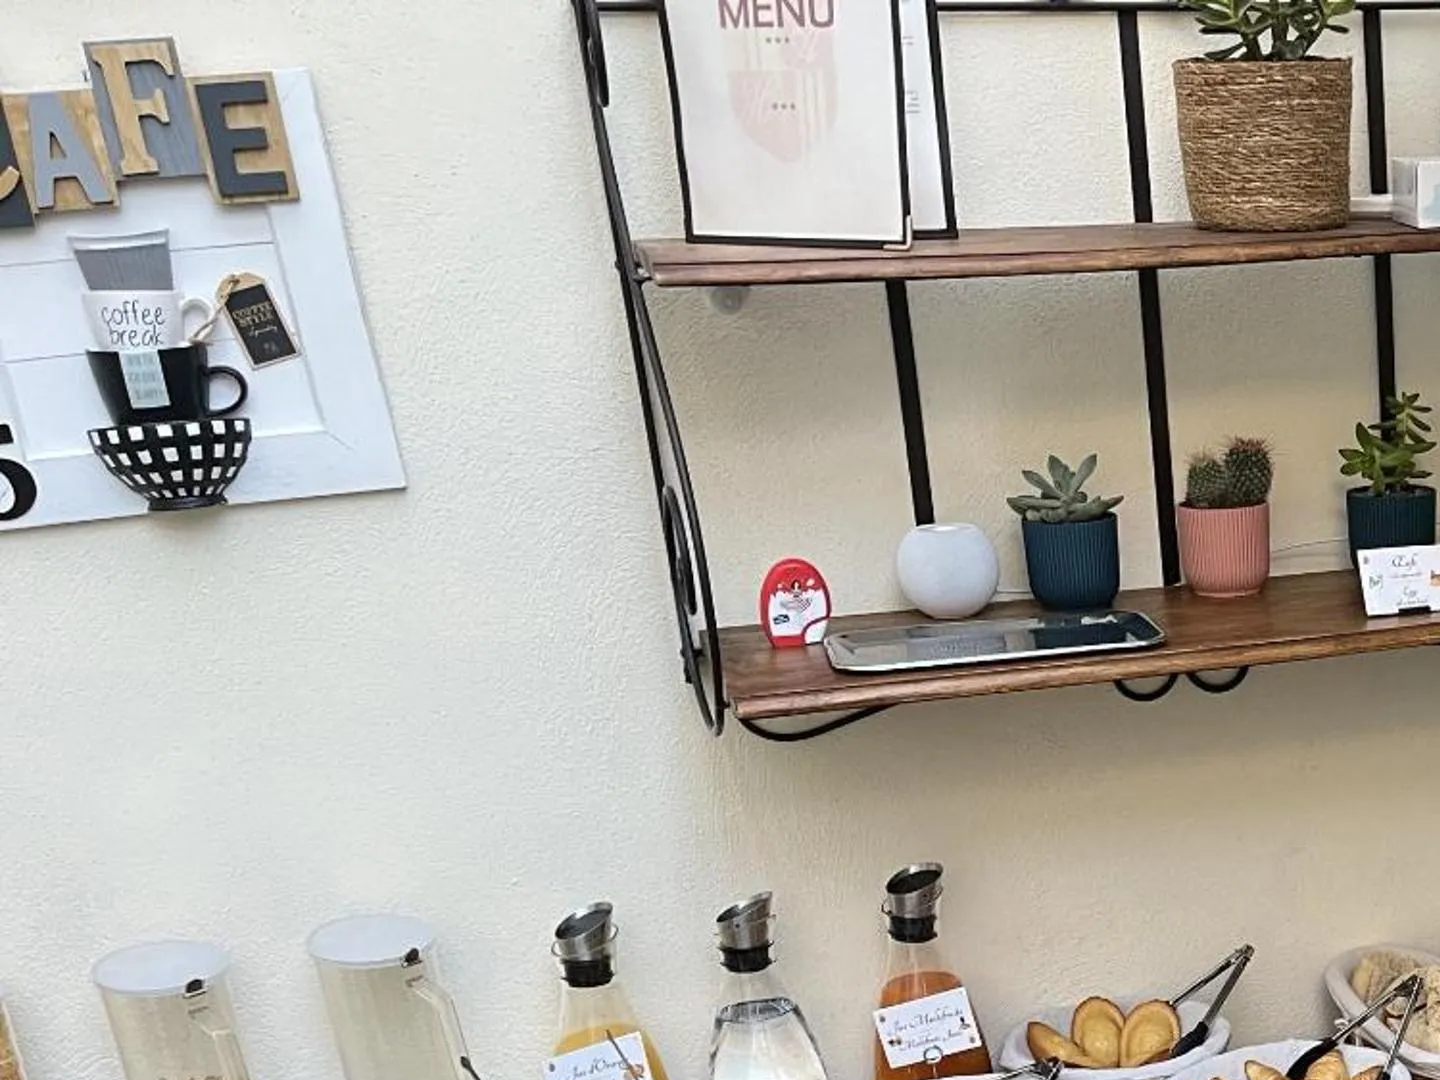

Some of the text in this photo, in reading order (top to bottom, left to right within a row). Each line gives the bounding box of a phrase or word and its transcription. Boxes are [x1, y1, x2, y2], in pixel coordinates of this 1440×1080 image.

[719, 0, 835, 29] MENU
[0, 56, 289, 211] AFE
[101, 299, 166, 329] coffee
[109, 325, 164, 347] break
